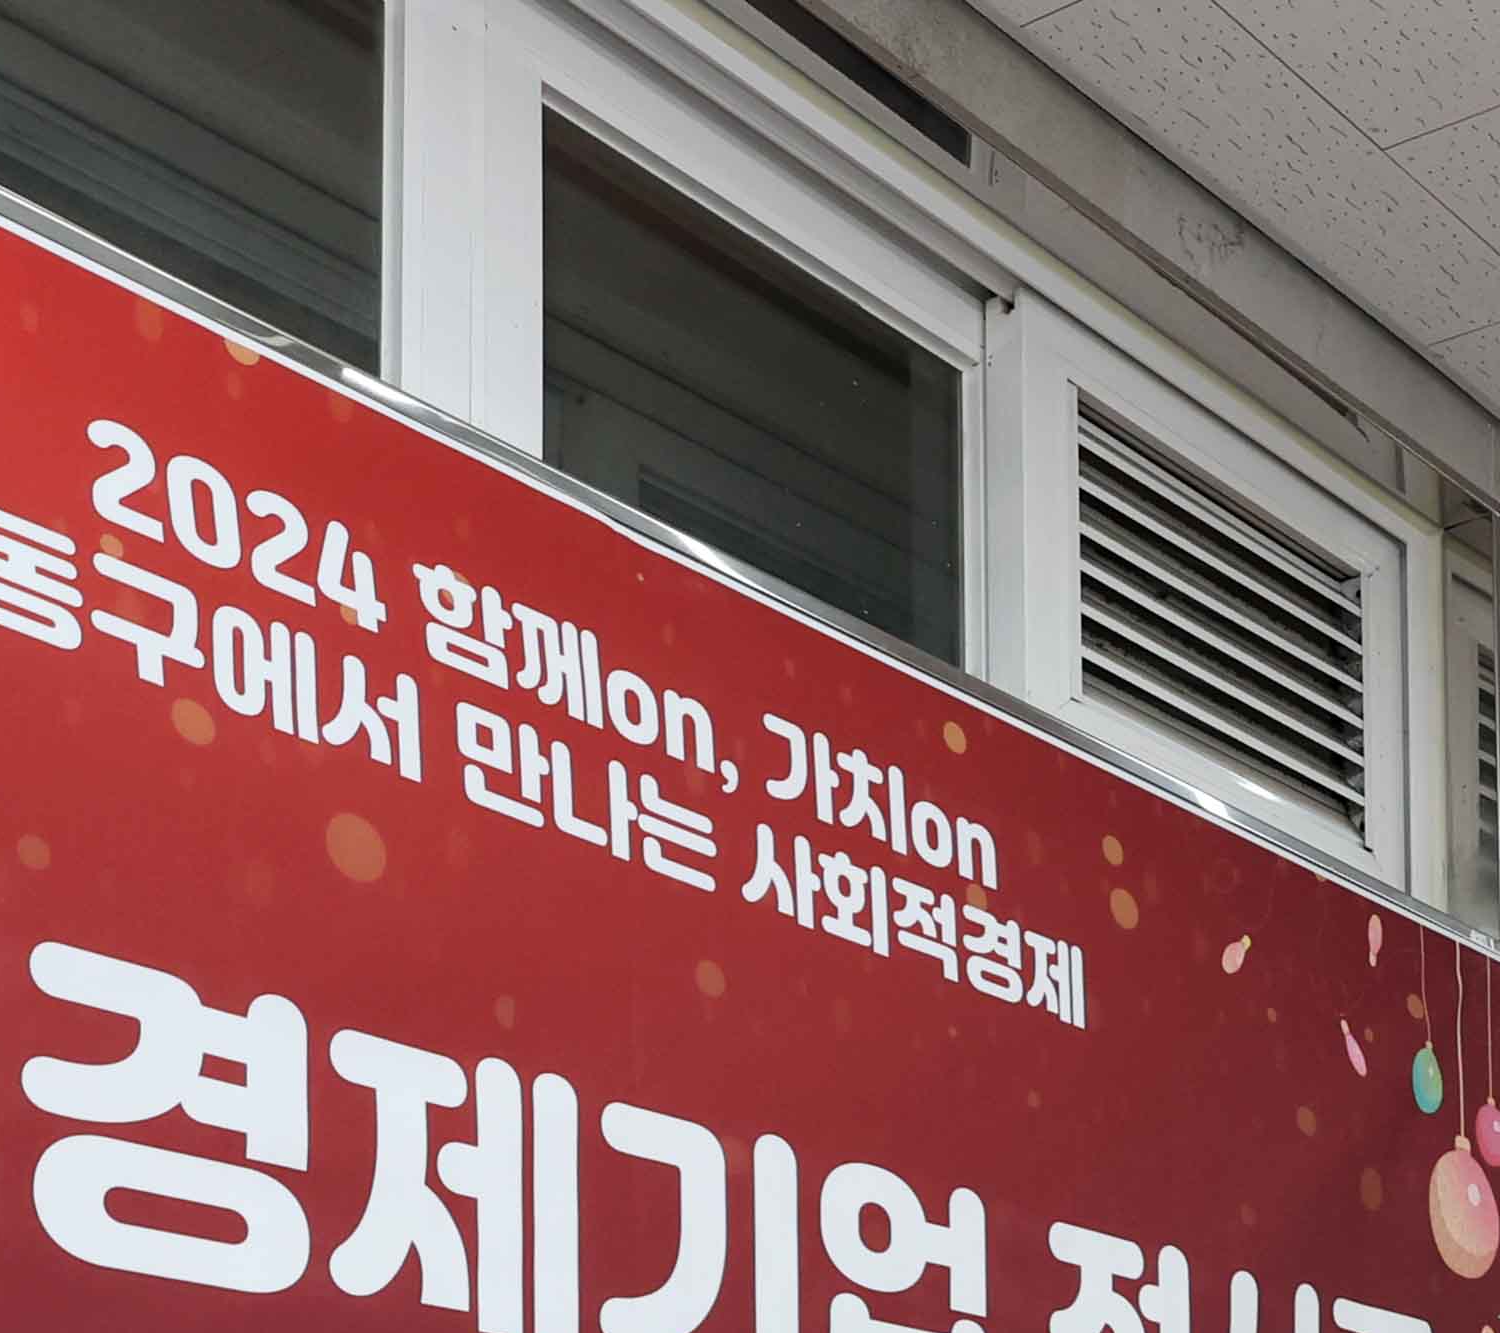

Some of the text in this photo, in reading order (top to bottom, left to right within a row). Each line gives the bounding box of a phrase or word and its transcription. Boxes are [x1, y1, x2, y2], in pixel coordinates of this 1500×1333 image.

[86, 420, 1000, 888] 2024 함께on, 가치on
[456, 711, 717, 895] 만나는
[743, 824, 1085, 1030] 사회적경제
